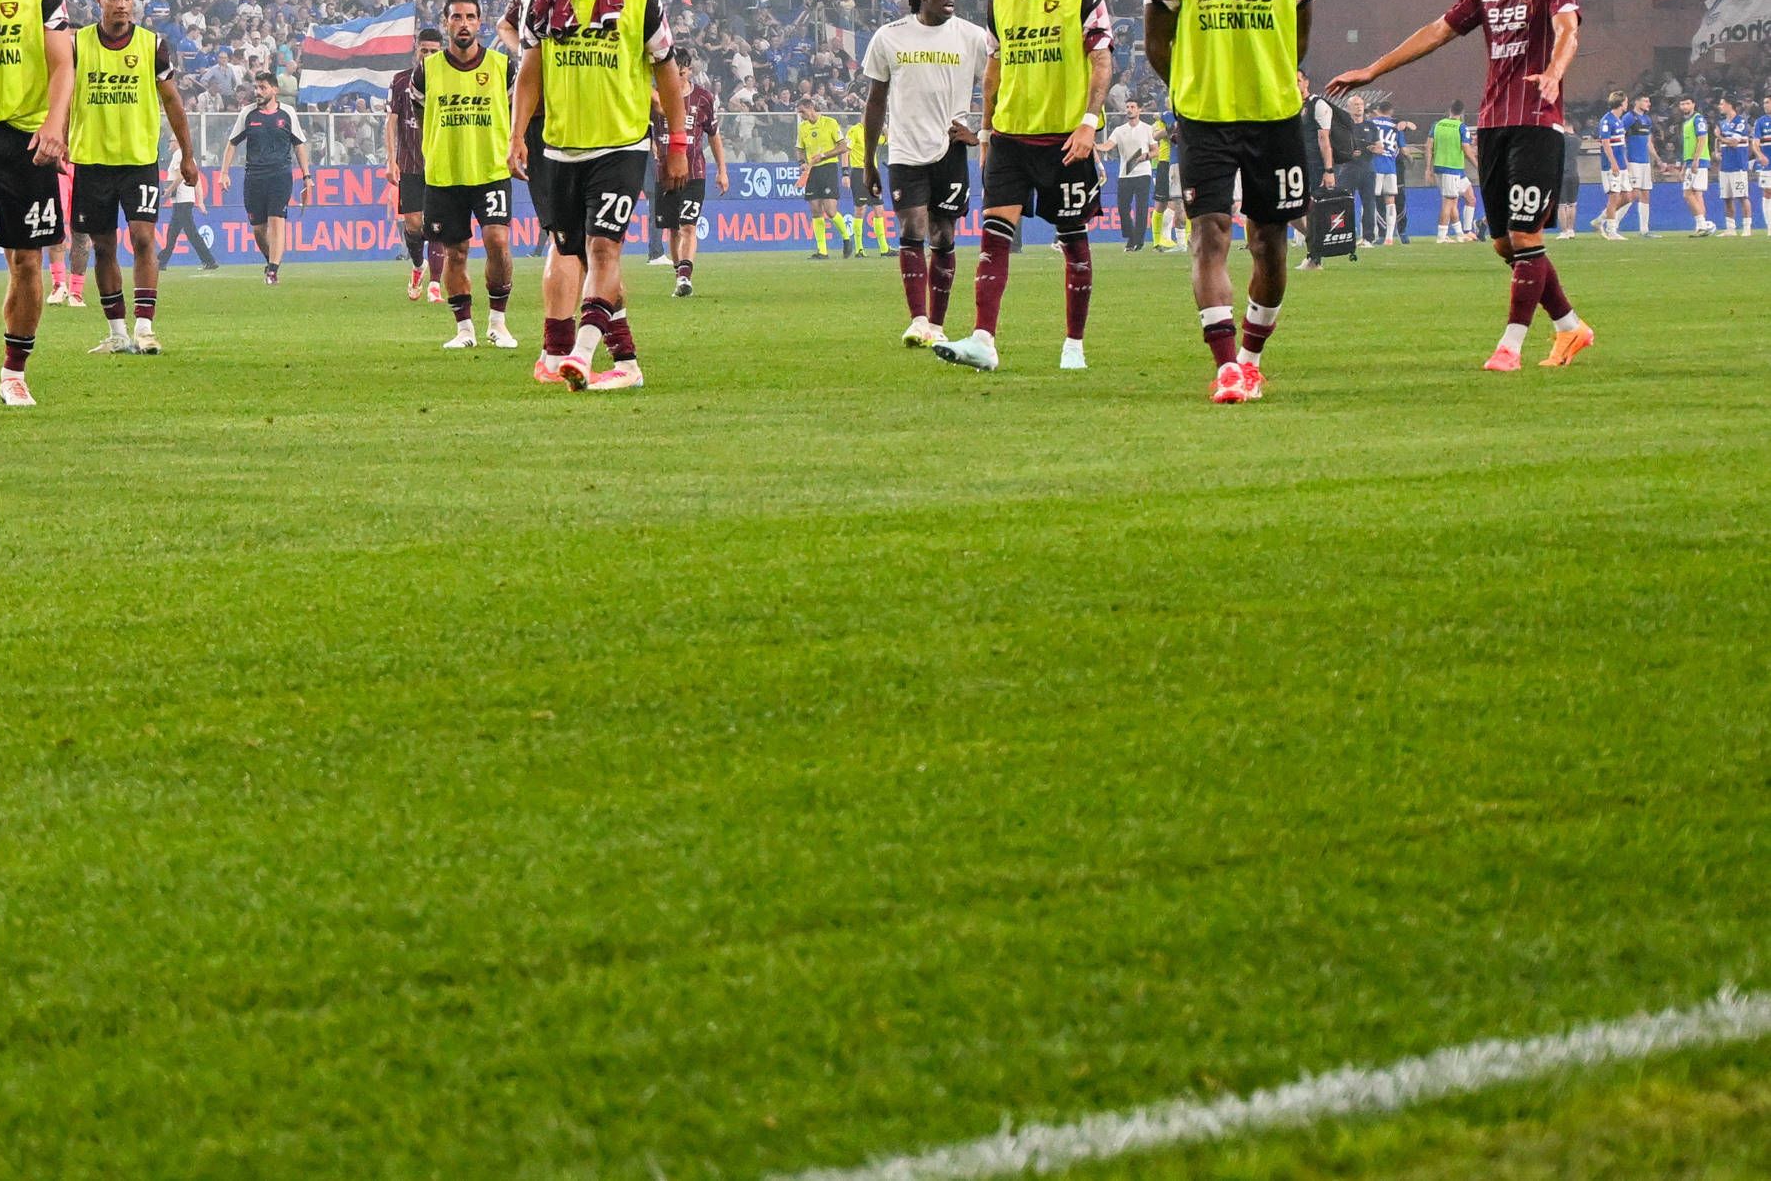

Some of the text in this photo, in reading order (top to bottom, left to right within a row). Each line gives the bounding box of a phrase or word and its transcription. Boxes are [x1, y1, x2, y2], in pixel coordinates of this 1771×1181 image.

[1198, 12, 1275, 31] SALERNITANA
[1016, 25, 1062, 39] Zeus
[896, 51, 961, 66] SALERNITANA
[1005, 47, 1063, 66] SALERNITANA
[98, 72, 140, 84] Zeus
[87, 92, 139, 105] SALERNITANA
[449, 94, 491, 106] Zeus
[440, 114, 493, 127] SALERNITANA
[776, 167, 800, 180] IDEE
[1275, 166, 1304, 200] 19
[139, 184, 158, 208] 17
[485, 190, 507, 212] 31
[946, 183, 962, 204] 7
[1060, 182, 1086, 208] 15
[1509, 184, 1541, 214] 99
[596, 192, 633, 224] 70
[1276, 199, 1304, 210] Zeus
[24, 198, 57, 229] 44
[29, 228, 55, 239] Zeus
[594, 218, 622, 232] Zeus
[221, 221, 404, 253] THILANDIA
[1323, 232, 1353, 243] Zeus
